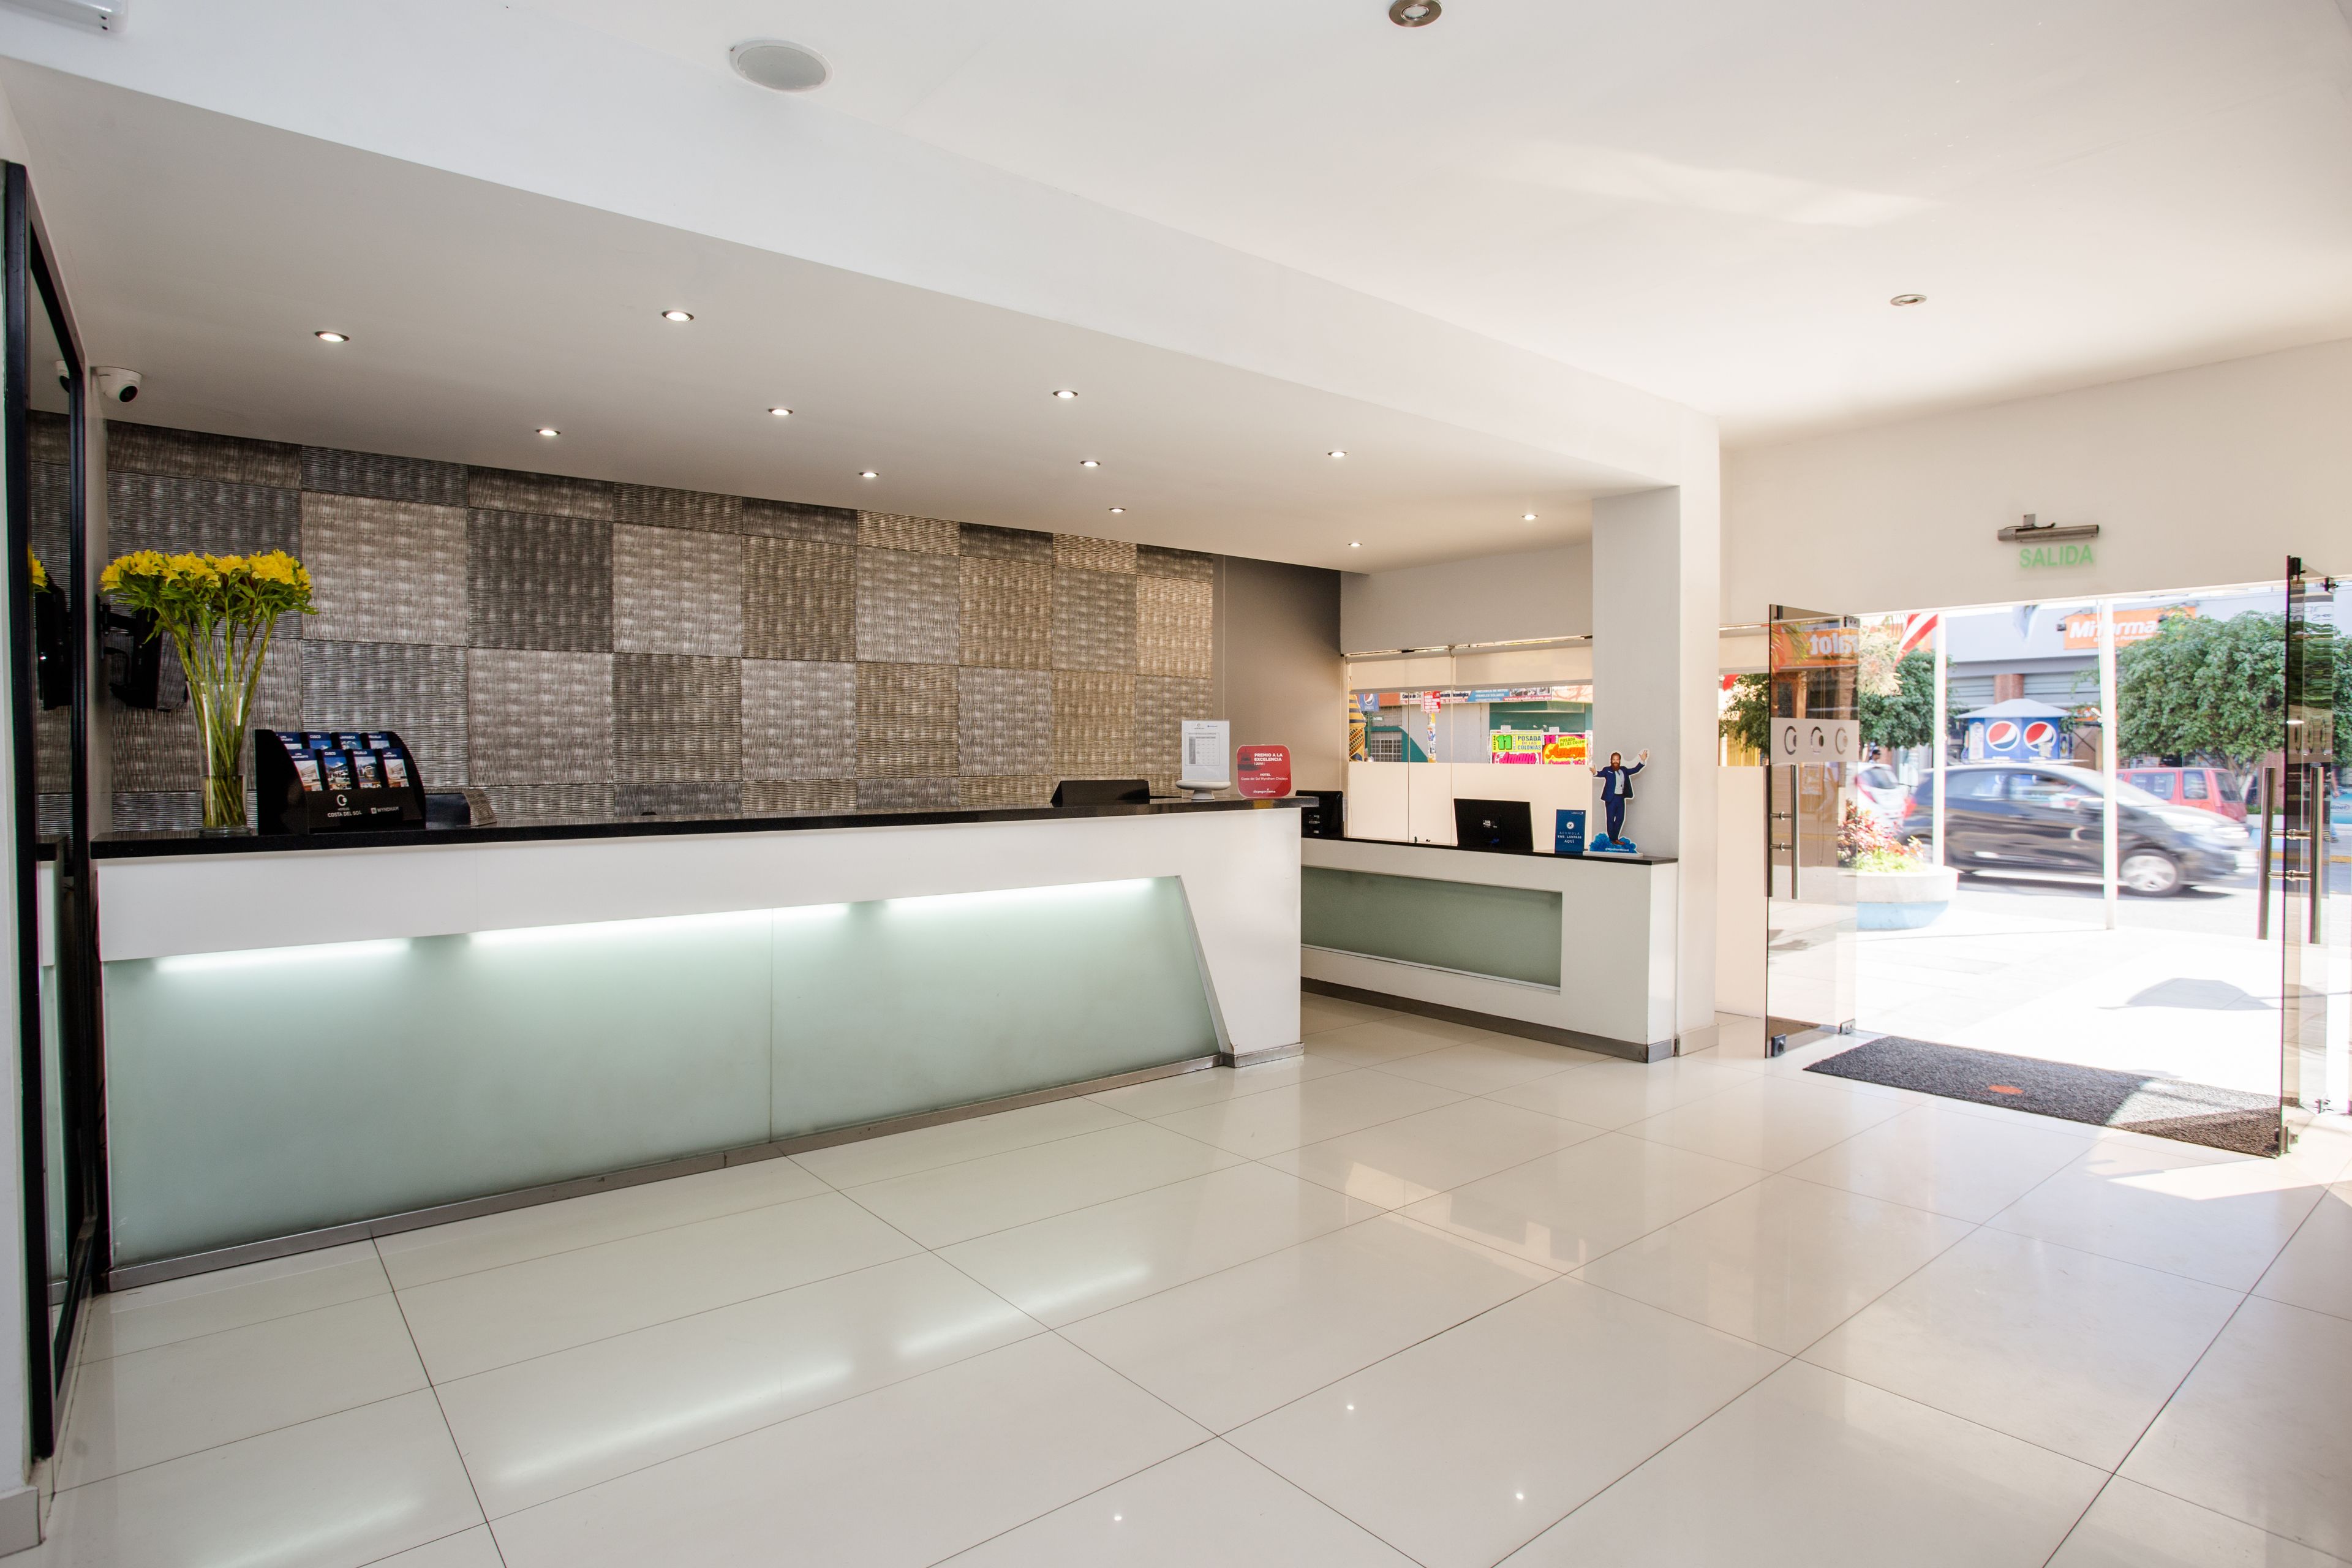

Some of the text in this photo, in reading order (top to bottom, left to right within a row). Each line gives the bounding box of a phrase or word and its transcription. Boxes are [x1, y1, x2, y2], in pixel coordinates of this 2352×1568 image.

[2019, 545, 2094, 568] SALIDA
[2069, 620, 2157, 638] Mirma
[1496, 735, 1512, 750] 11
